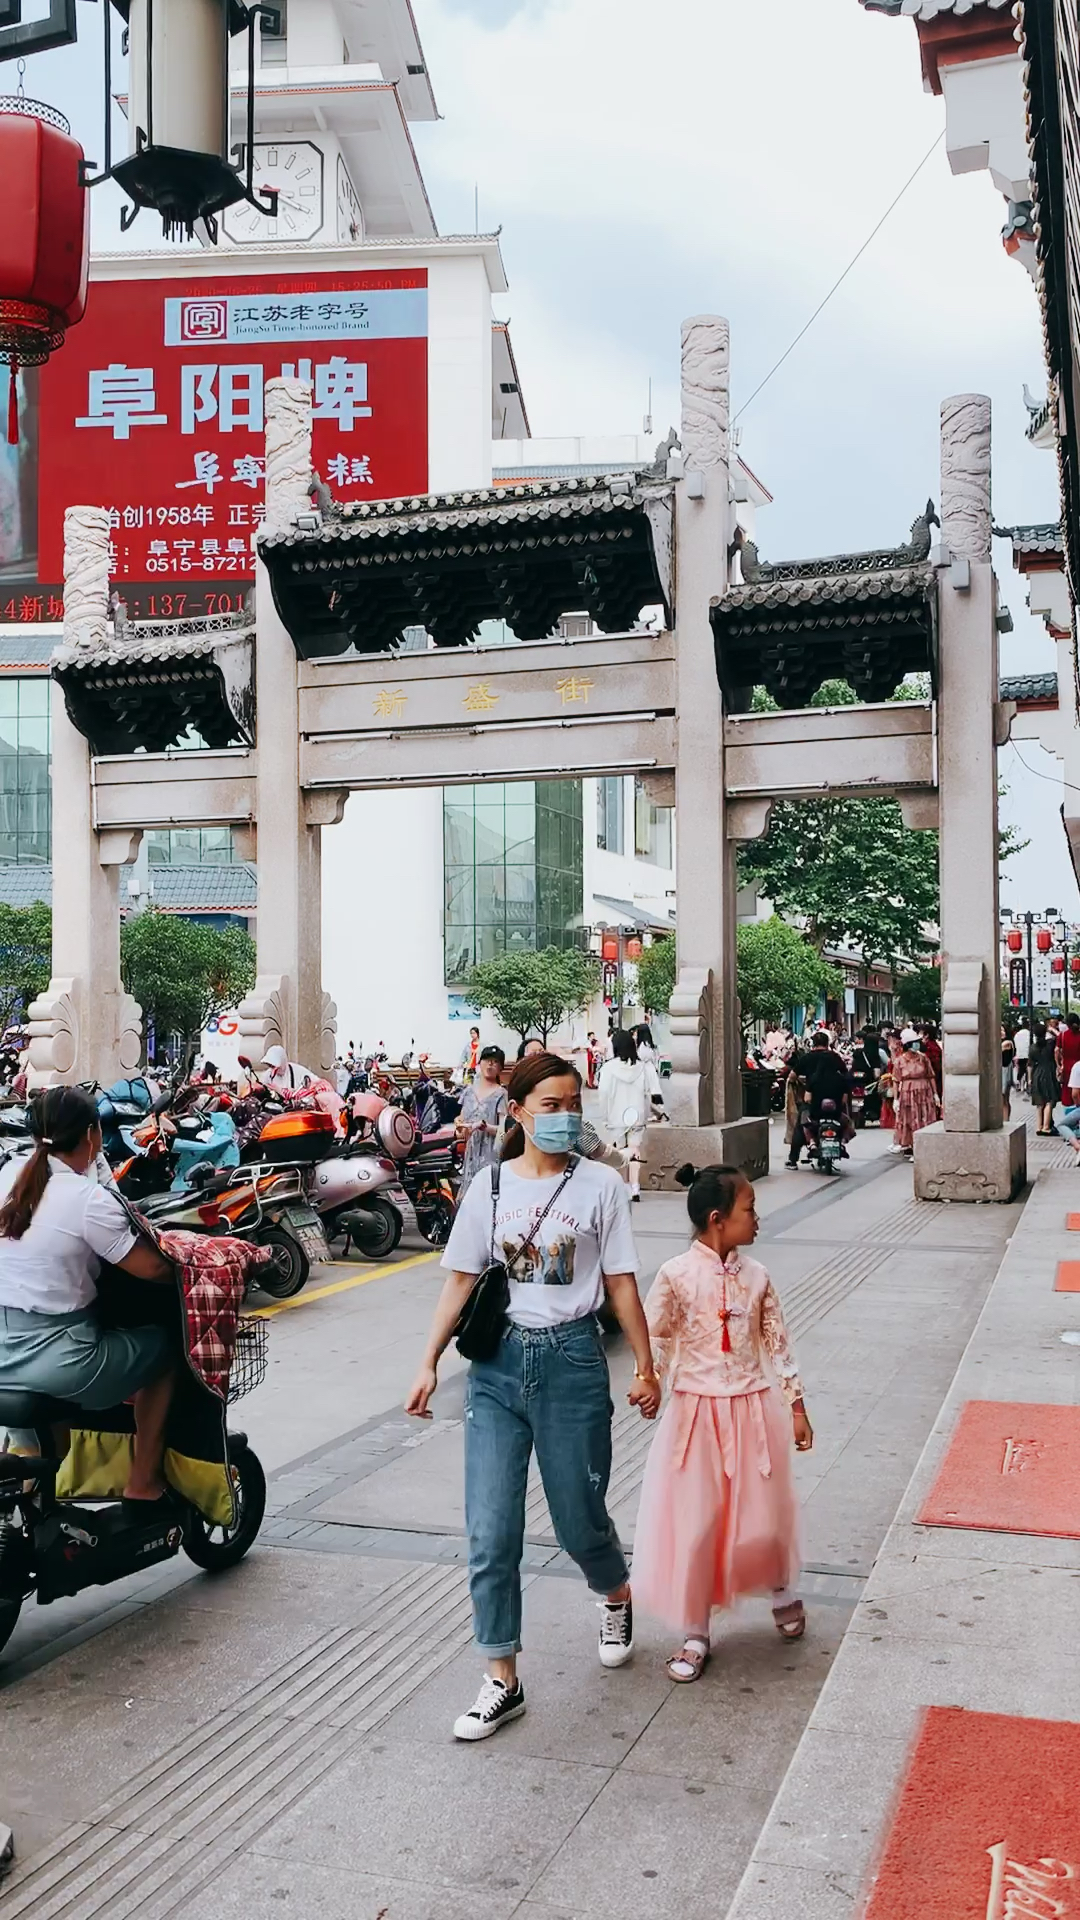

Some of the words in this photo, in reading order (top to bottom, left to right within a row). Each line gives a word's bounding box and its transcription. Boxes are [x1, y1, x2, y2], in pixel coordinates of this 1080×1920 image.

[233, 302, 369, 323] 江苏老字号
[233, 324, 270, 336] JiangSu
[273, 321, 339, 332] Time-honored
[341, 321, 370, 330] Brand
[75, 356, 372, 439] 阜阳牌
[371, 676, 596, 718] 新盛街
[528, 1207, 580, 1232] FETIVAL
